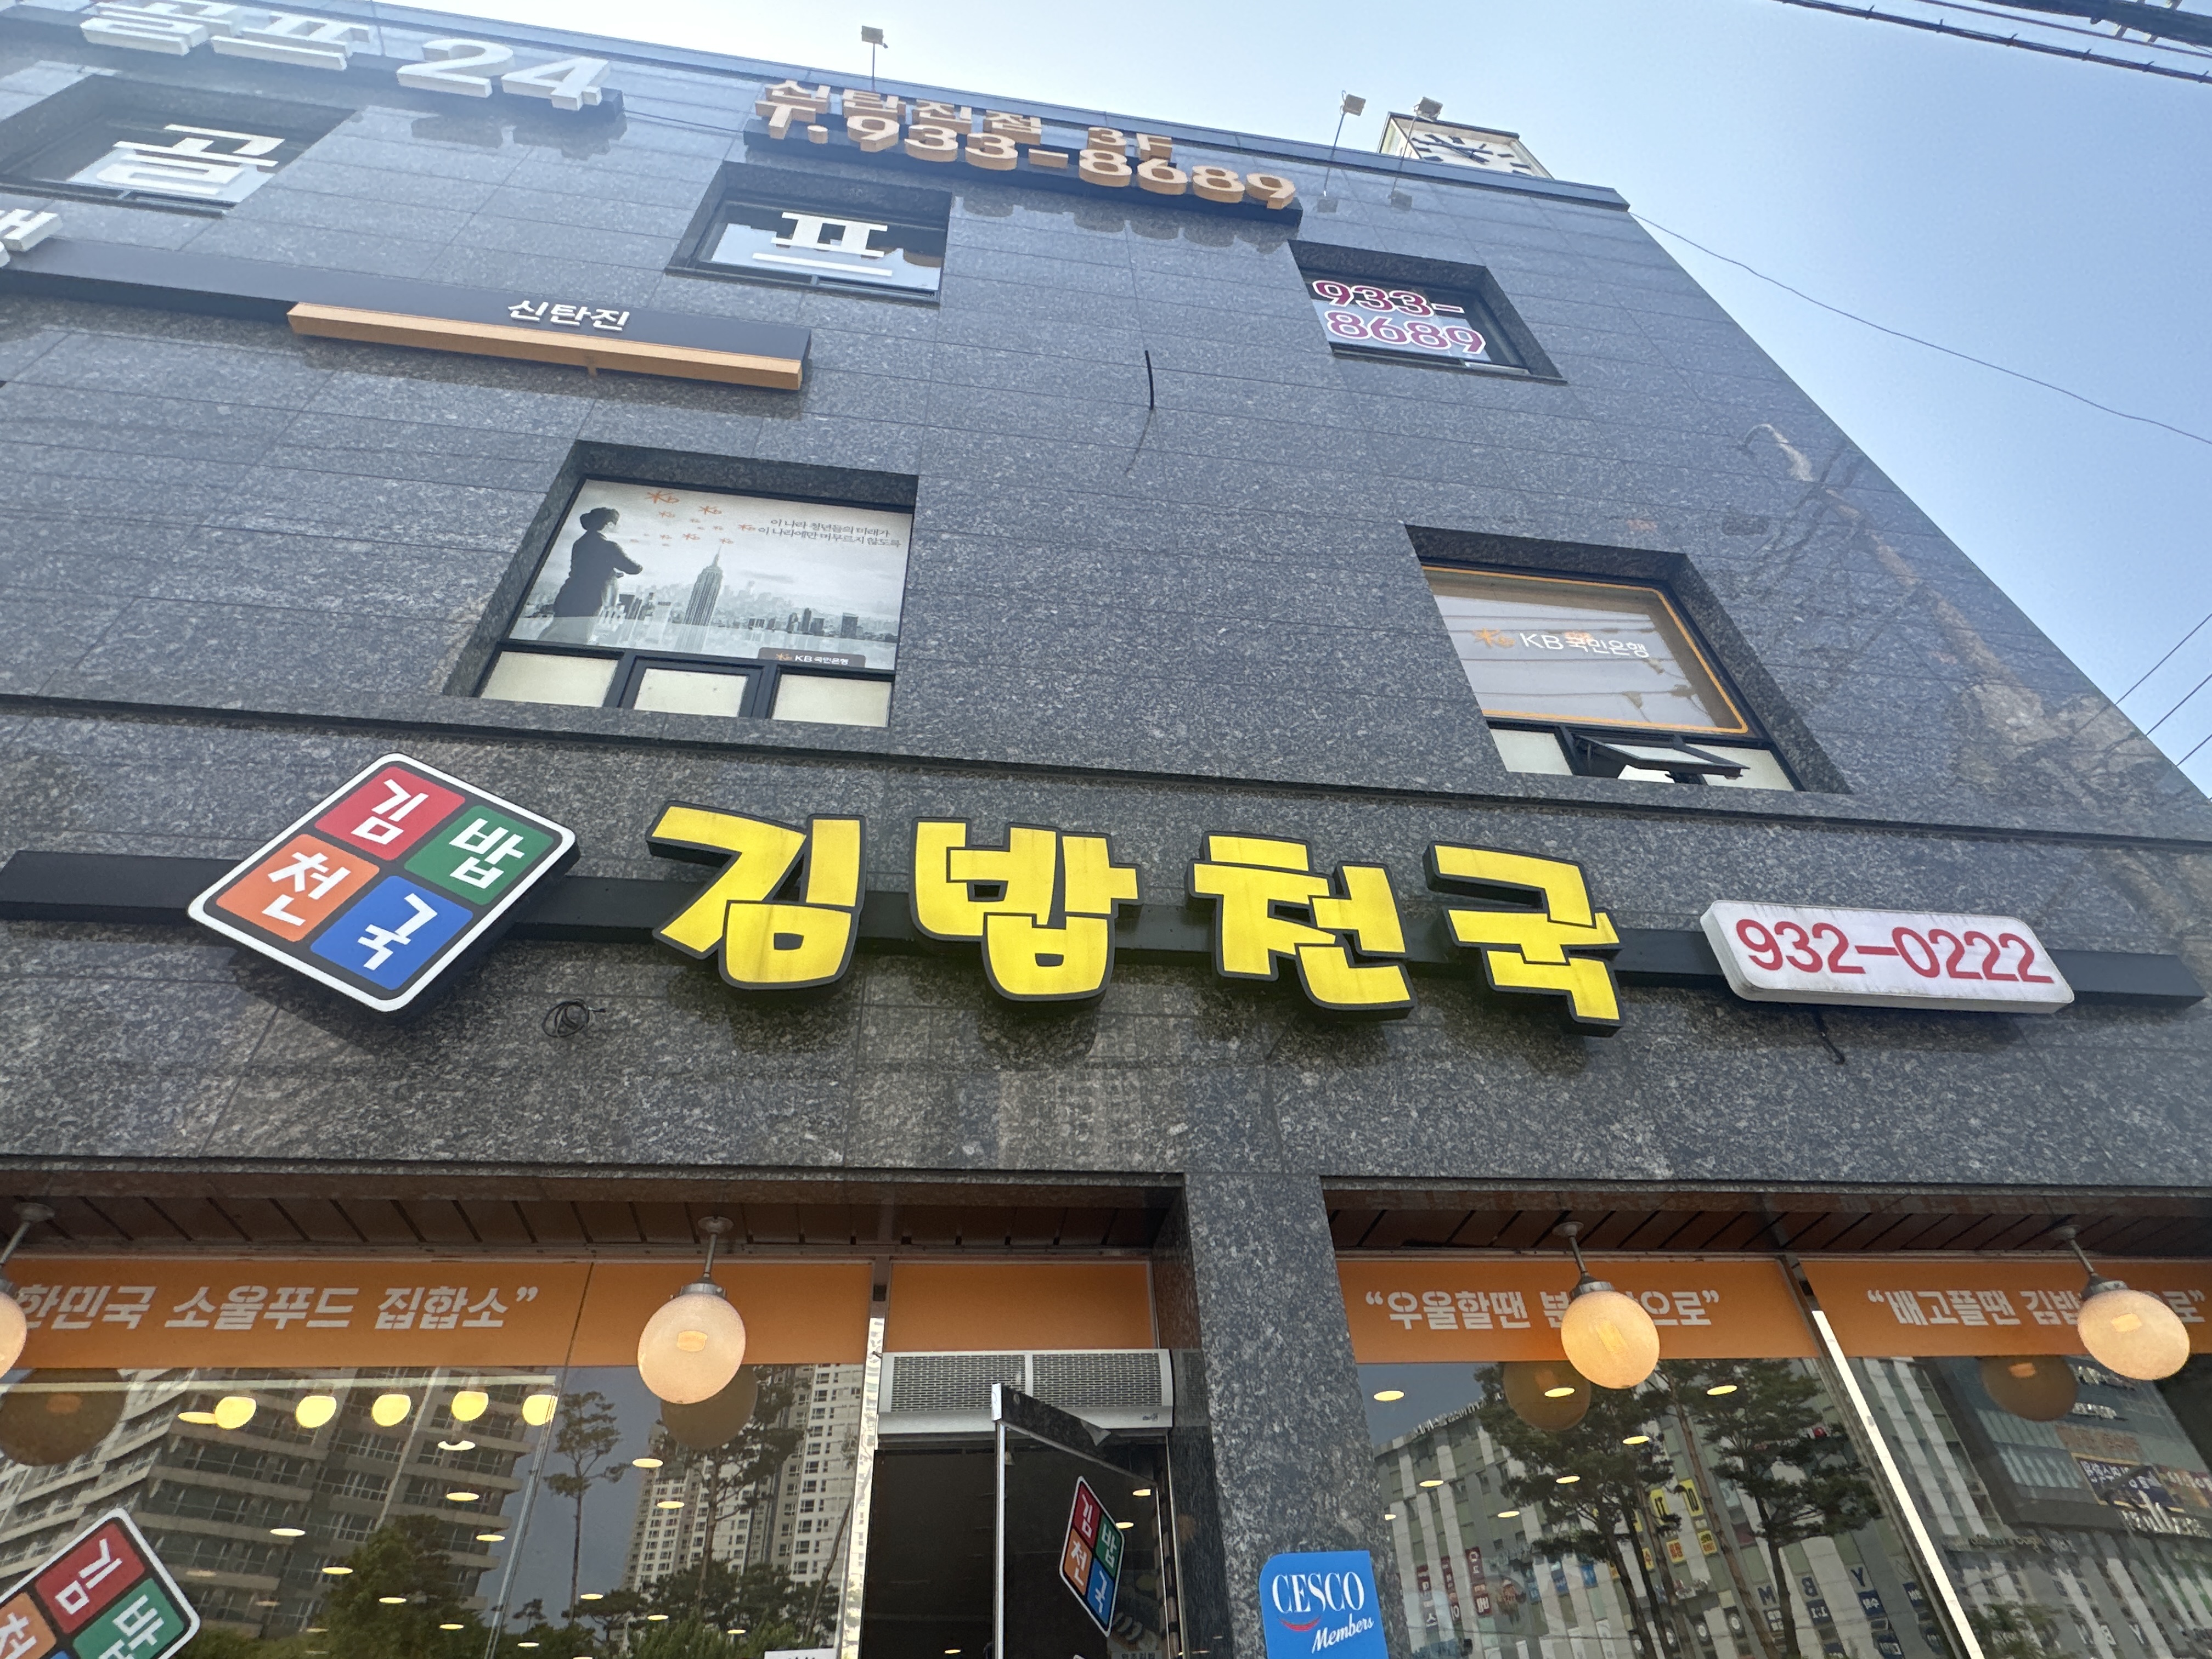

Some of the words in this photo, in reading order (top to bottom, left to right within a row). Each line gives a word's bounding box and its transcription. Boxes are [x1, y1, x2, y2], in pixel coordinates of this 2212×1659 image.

[396, 38, 611, 111] 24
[508, 300, 630, 331] 신탄진
[1313, 280, 1465, 317] 933-
[1324, 310, 1486, 354] 8689
[758, 527, 769, 535] 이
[785, 520, 807, 529] 나라
[646, 803, 1624, 1030] 김밥천국
[1736, 918, 2054, 984] 932-0222
[164, 1285, 359, 1330] 소울푸드
[1272, 1571, 1365, 1614] CESCO
[1312, 1613, 1374, 1654] Members
